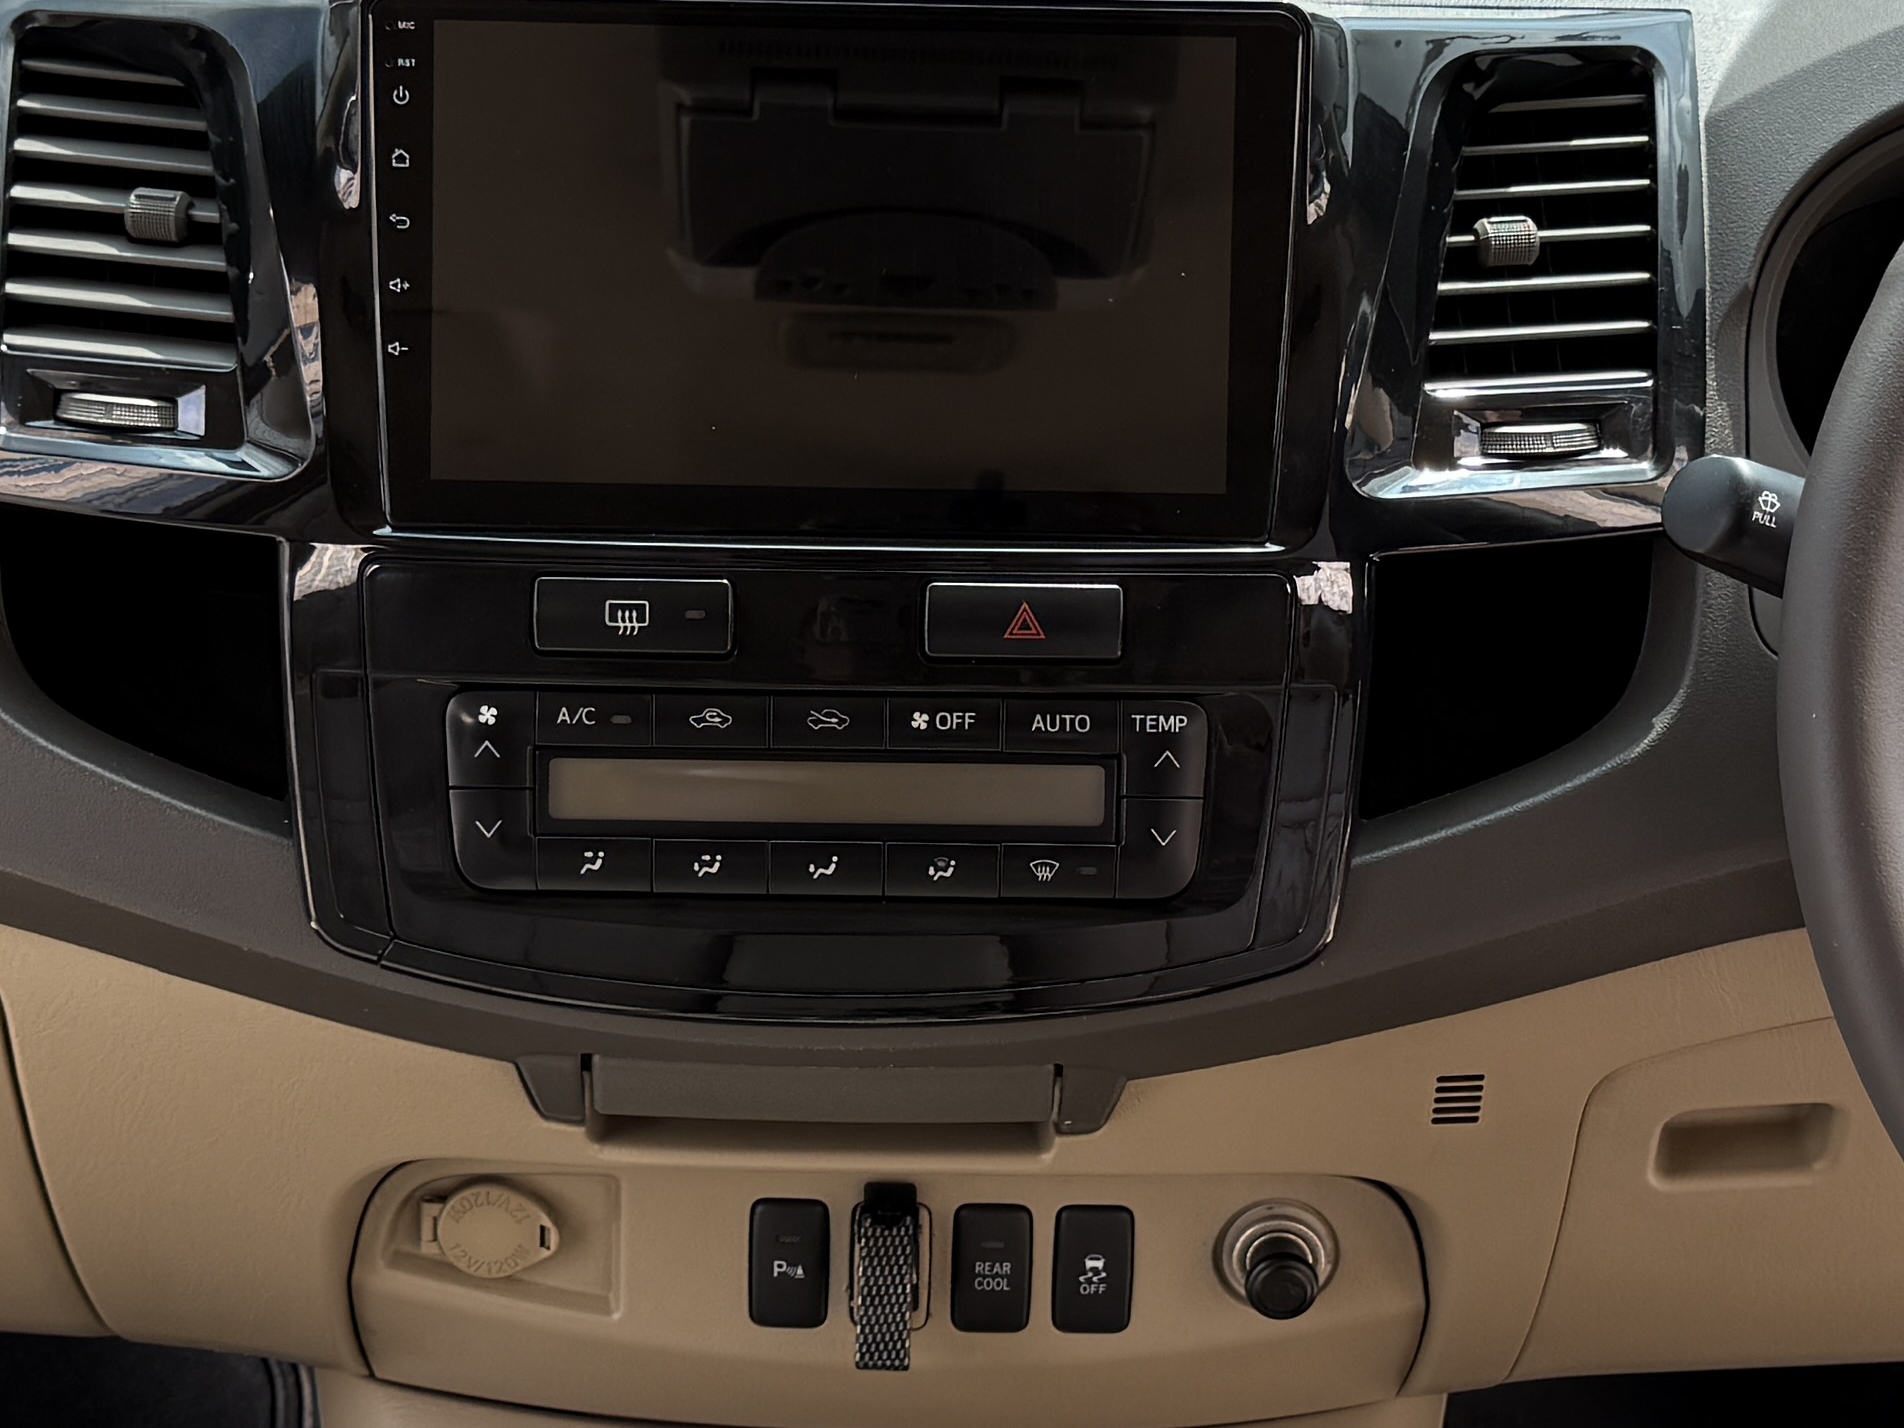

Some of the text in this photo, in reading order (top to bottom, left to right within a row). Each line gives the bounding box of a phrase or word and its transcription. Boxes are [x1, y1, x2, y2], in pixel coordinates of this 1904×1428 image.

[398, 58, 415, 67] RST
[1752, 511, 1777, 528] PULL
[556, 706, 597, 725] A/C
[935, 711, 976, 731] OFF
[1031, 714, 1091, 733] AUTO
[1131, 714, 1188, 734] TEMP
[448, 1243, 531, 1275] 12V/120W
[974, 1261, 1011, 1276] REAR
[974, 1276, 1011, 1291] COOL
[1079, 1283, 1107, 1296] OFF
